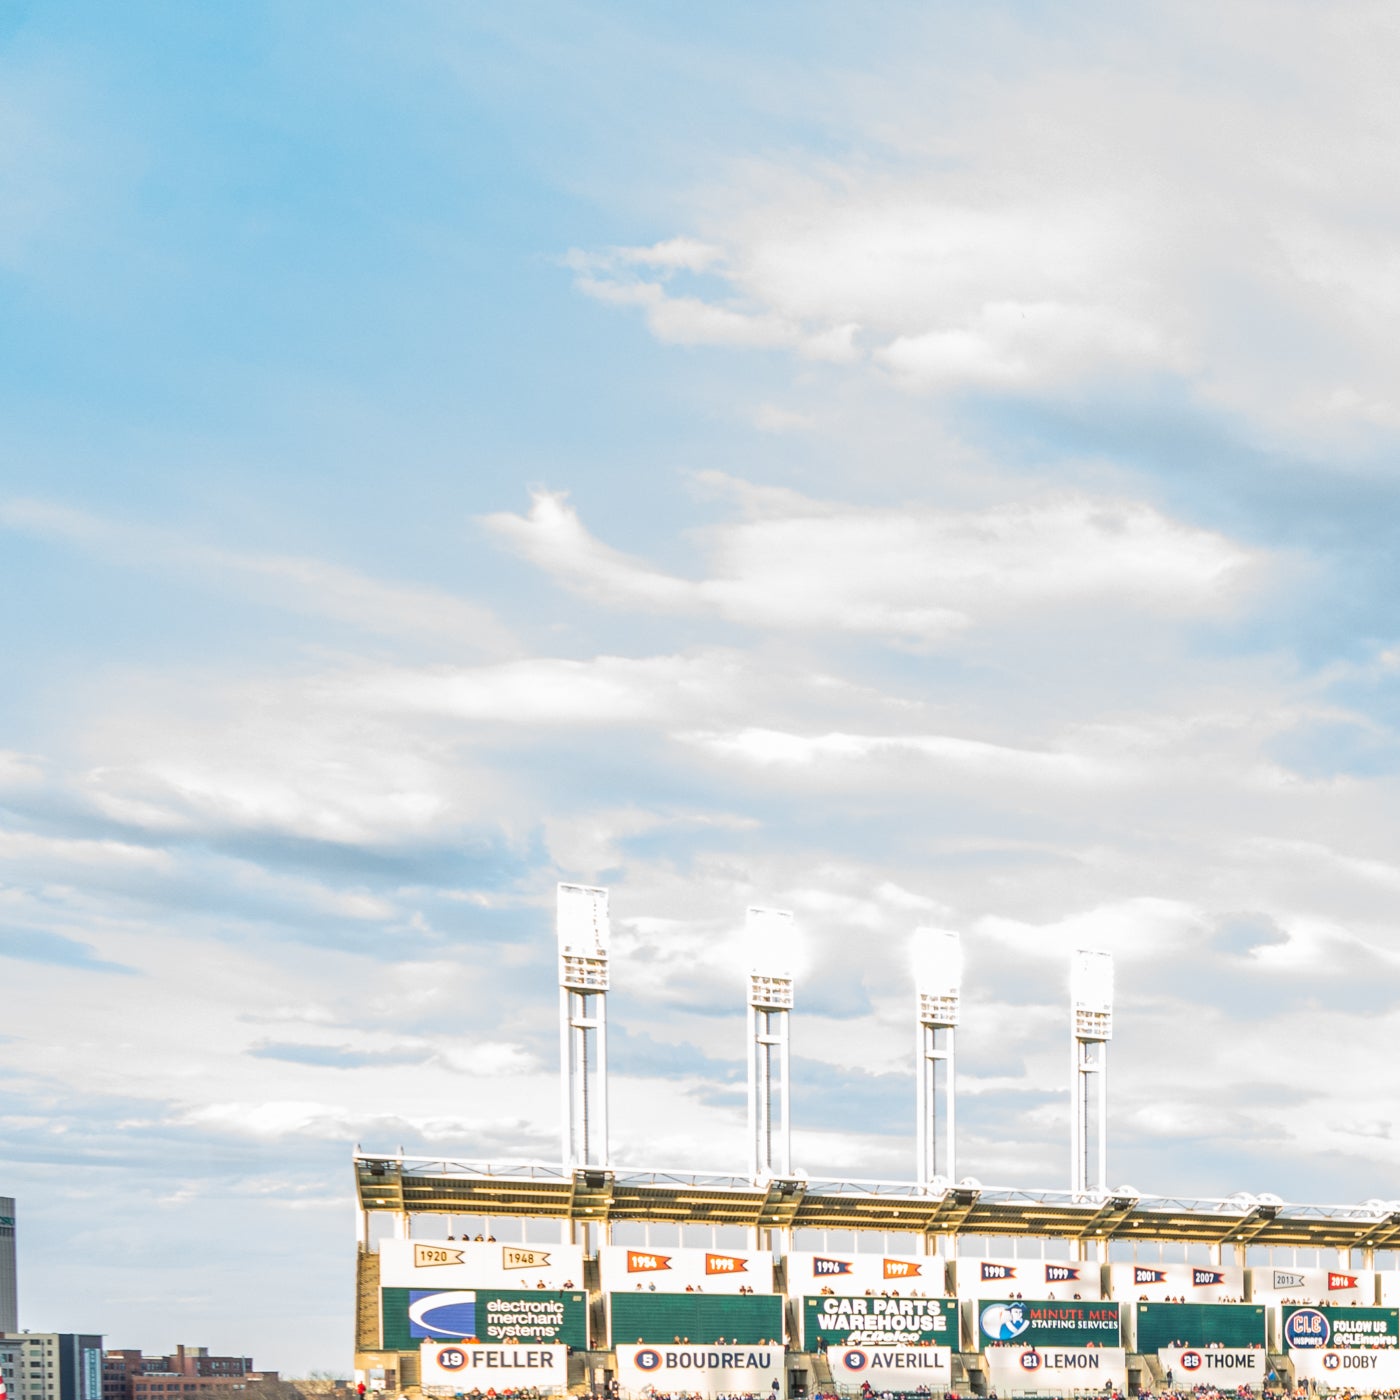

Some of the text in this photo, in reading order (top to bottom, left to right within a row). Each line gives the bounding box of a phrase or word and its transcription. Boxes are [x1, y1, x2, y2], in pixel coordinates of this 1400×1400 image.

[420, 1250, 448, 1262] 1920
[508, 1253, 534, 1264] 1948
[631, 1255, 658, 1268] 1954
[709, 1258, 735, 1271] 1995
[816, 1260, 840, 1273] 1996
[886, 1263, 909, 1275] 1997
[983, 1265, 1006, 1278] 1998
[1048, 1267, 1069, 1280] 1999
[1136, 1270, 1156, 1282] 2001
[1195, 1271, 1214, 1283] 2007
[1276, 1275, 1295, 1285] 2013
[1331, 1276, 1349, 1287] 2016
[486, 1299, 564, 1313] electronic
[823, 1298, 941, 1316] CAR PARTS
[486, 1312, 564, 1325] merchant
[1029, 1308, 1118, 1320] MINUTE MEN
[817, 1314, 947, 1332] WAREHOUSE
[1031, 1319, 1119, 1330] STAFFING SERVICES
[1293, 1315, 1323, 1334] CLE
[1332, 1320, 1388, 1333] FOLLOW US
[486, 1325, 556, 1339] systems
[1293, 1337, 1323, 1346] INSPIRES
[1332, 1333, 1398, 1347] @CLEinspires
[441, 1350, 554, 1369] 19 FELLER
[641, 1352, 772, 1370] 5 BOUDREAU
[849, 1352, 944, 1369] 3 AVERILL
[1023, 1353, 1100, 1369] 21 LEMON
[1183, 1353, 1256, 1369] 25 THOME
[1343, 1354, 1378, 1369] DOBY
